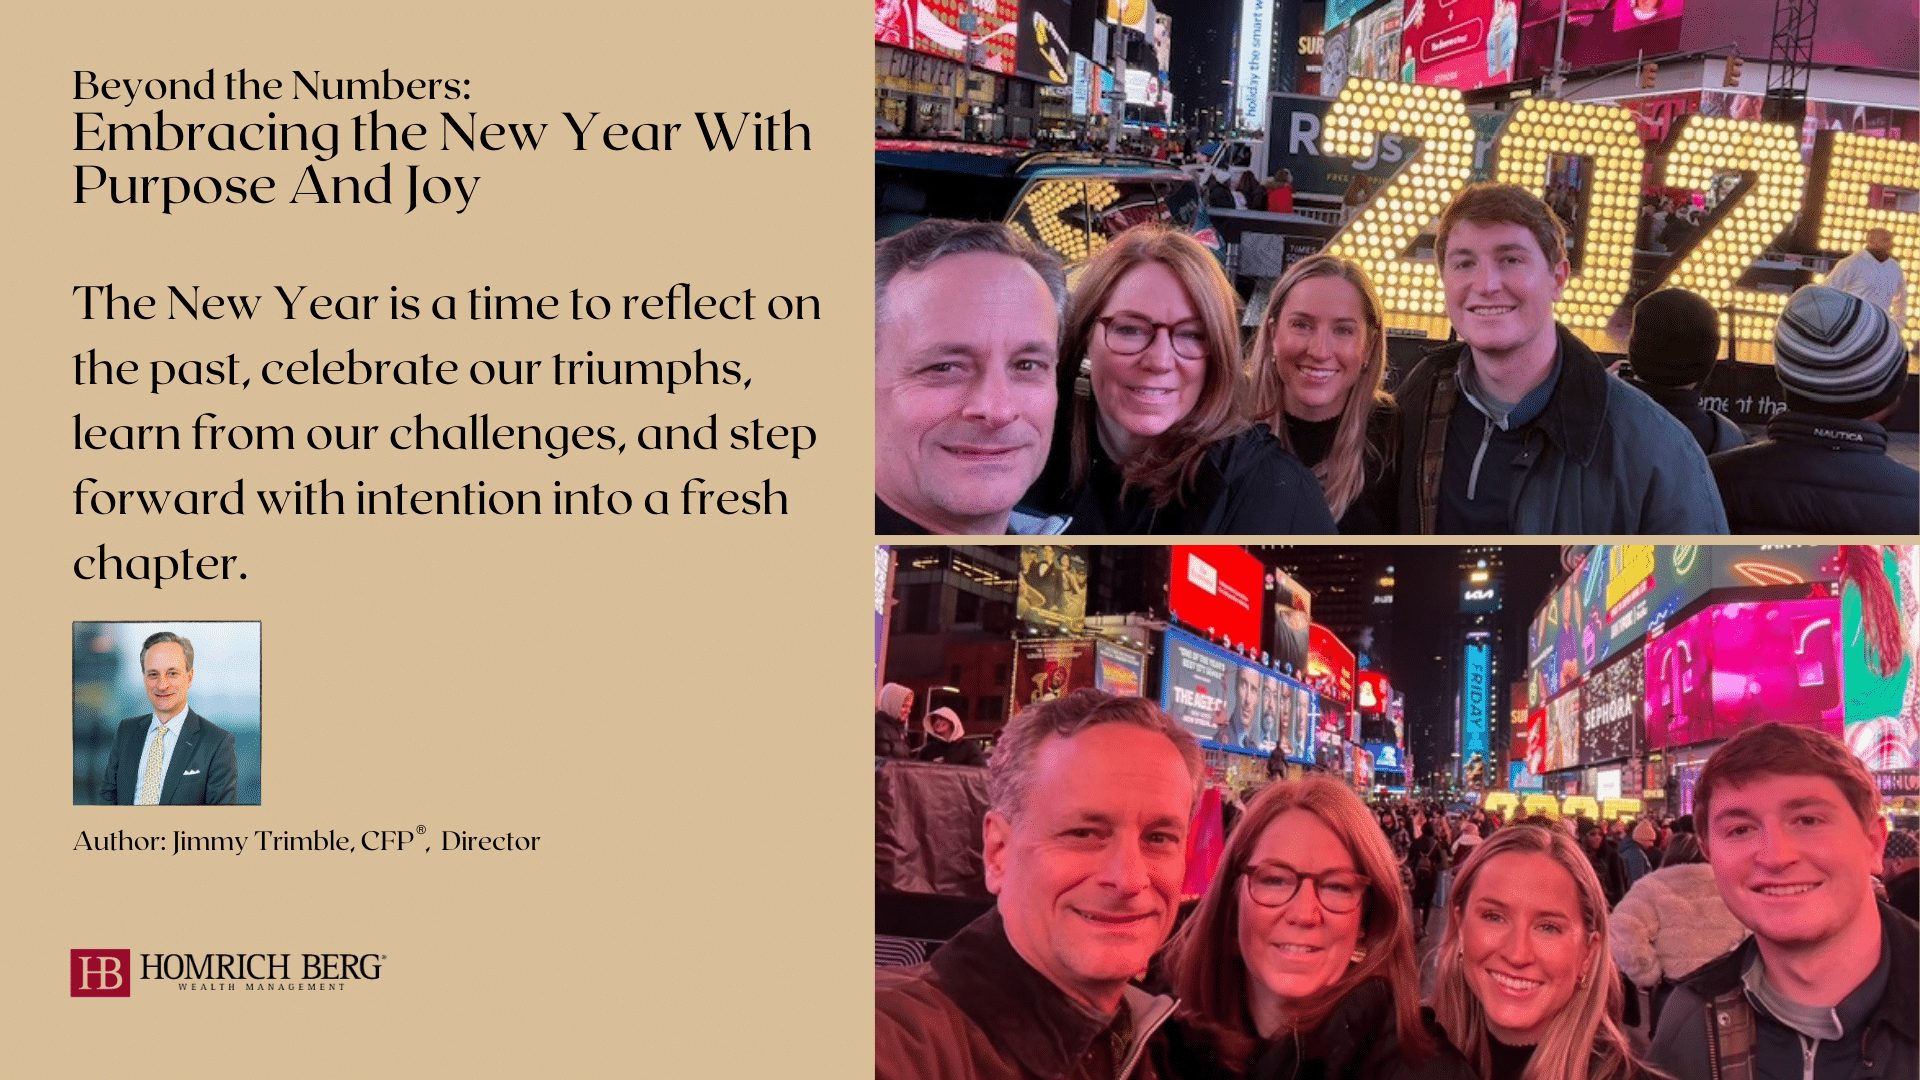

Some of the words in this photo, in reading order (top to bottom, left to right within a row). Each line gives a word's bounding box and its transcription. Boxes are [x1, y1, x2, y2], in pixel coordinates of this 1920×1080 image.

[1252, 12, 1263, 48] smart
[1248, 50, 1260, 71] the
[1245, 72, 1261, 117] holiday
[1814, 427, 1864, 442] NAUTICA
[1174, 686, 1194, 705] THE
[1470, 662, 1484, 730] FRIDAY
[1584, 692, 1633, 731] SEPHORA
